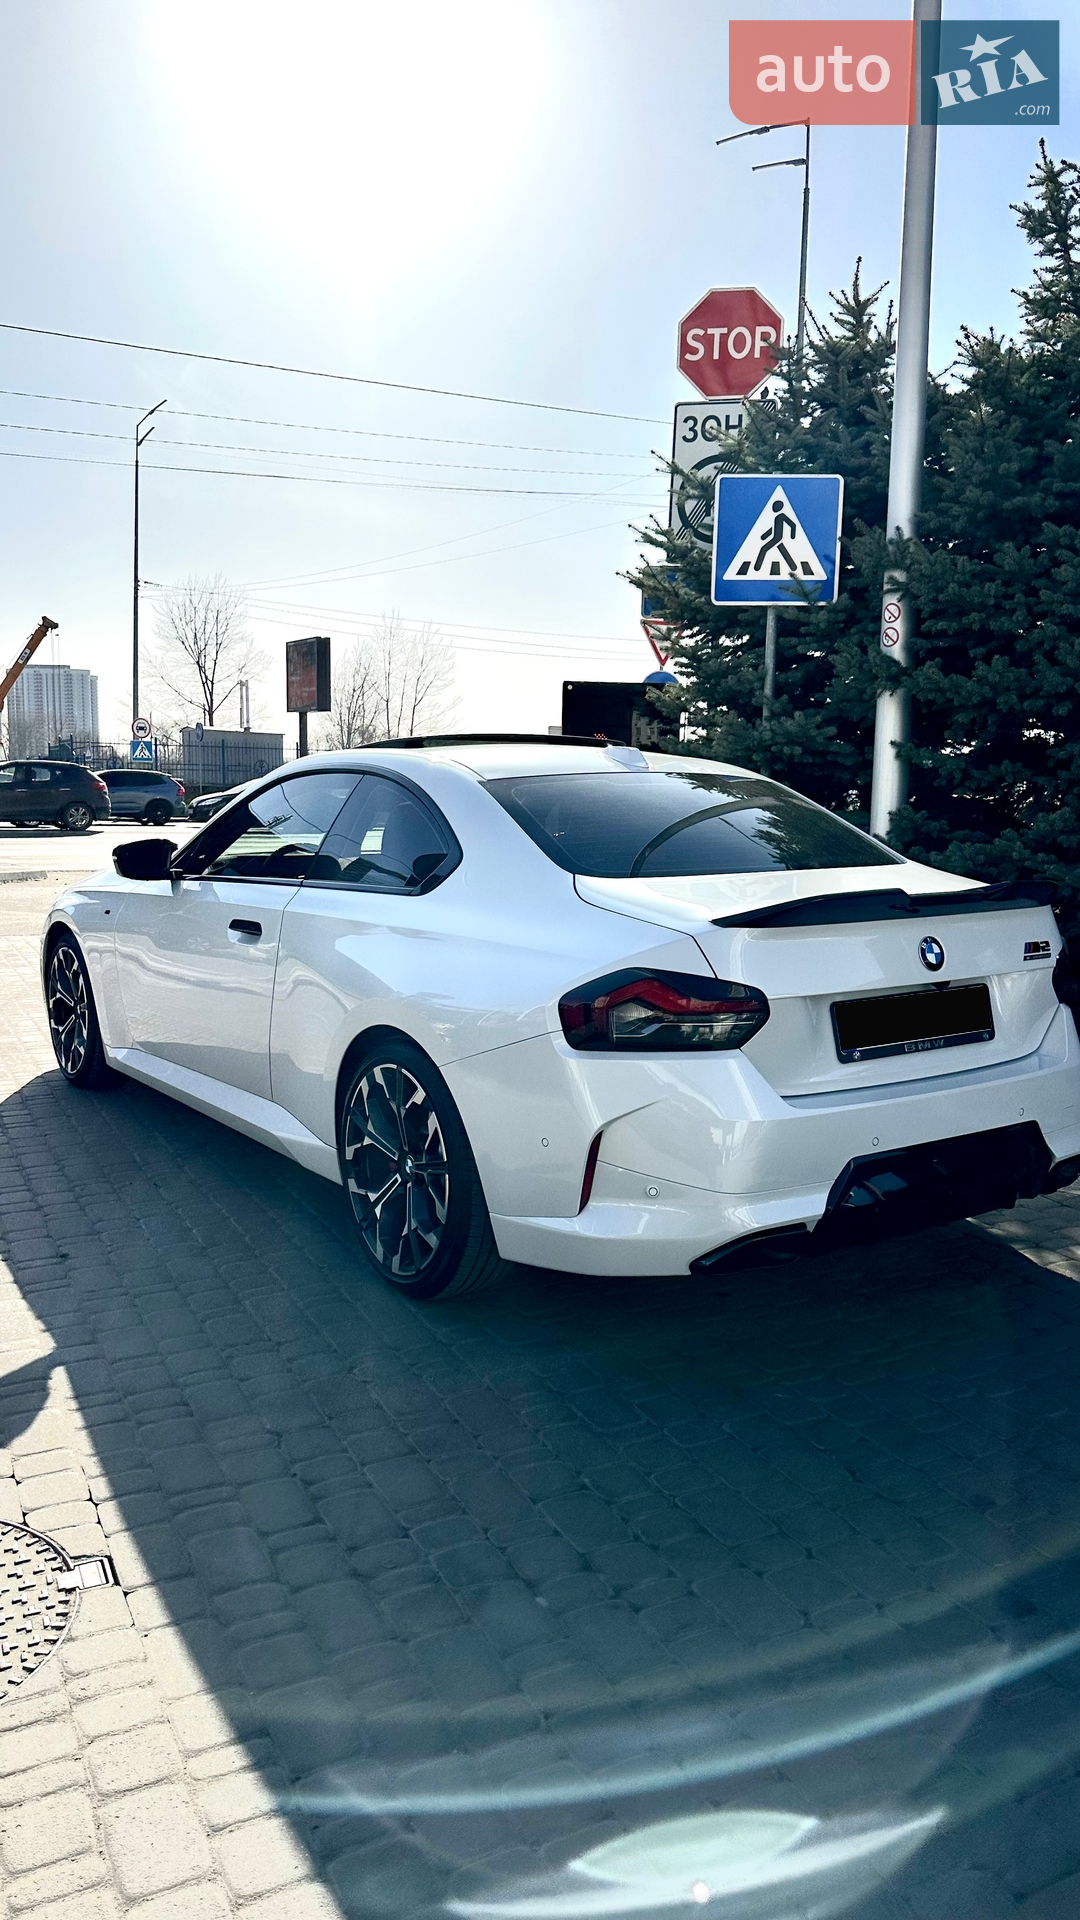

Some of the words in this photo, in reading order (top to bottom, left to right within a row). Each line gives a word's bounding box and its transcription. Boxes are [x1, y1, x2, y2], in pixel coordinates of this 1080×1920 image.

[684, 326, 777, 362] STOP
[682, 414, 743, 443] ЗОН
[904, 1039, 945, 1052] BMW
